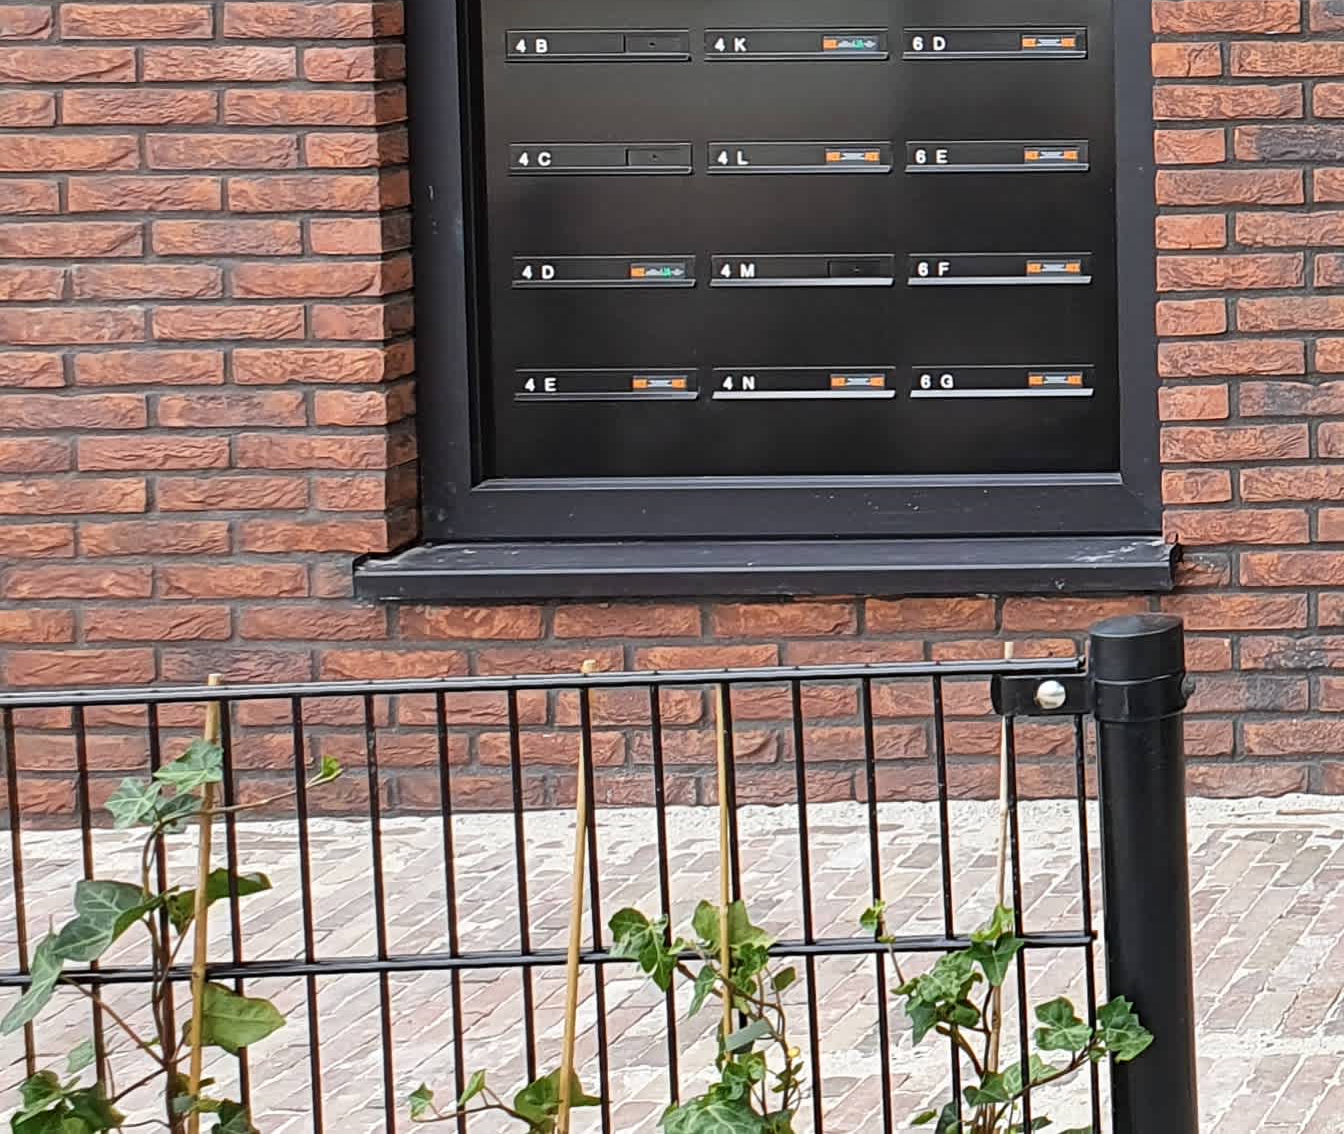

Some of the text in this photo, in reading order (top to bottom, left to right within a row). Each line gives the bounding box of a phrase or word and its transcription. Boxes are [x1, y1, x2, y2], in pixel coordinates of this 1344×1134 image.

[515, 38, 548, 54] 4 B
[714, 37, 747, 53] 4 K
[912, 36, 946, 51] 6 D
[518, 151, 552, 167] 4 C
[717, 150, 749, 166] 4 L
[915, 149, 948, 164] 6 E
[521, 264, 555, 280] 4 D
[720, 263, 755, 278] 4 M
[917, 261, 950, 277] 6 F
[524, 377, 557, 392] 4 E
[722, 375, 755, 391] 4 N
[920, 373, 954, 389] 6 G
